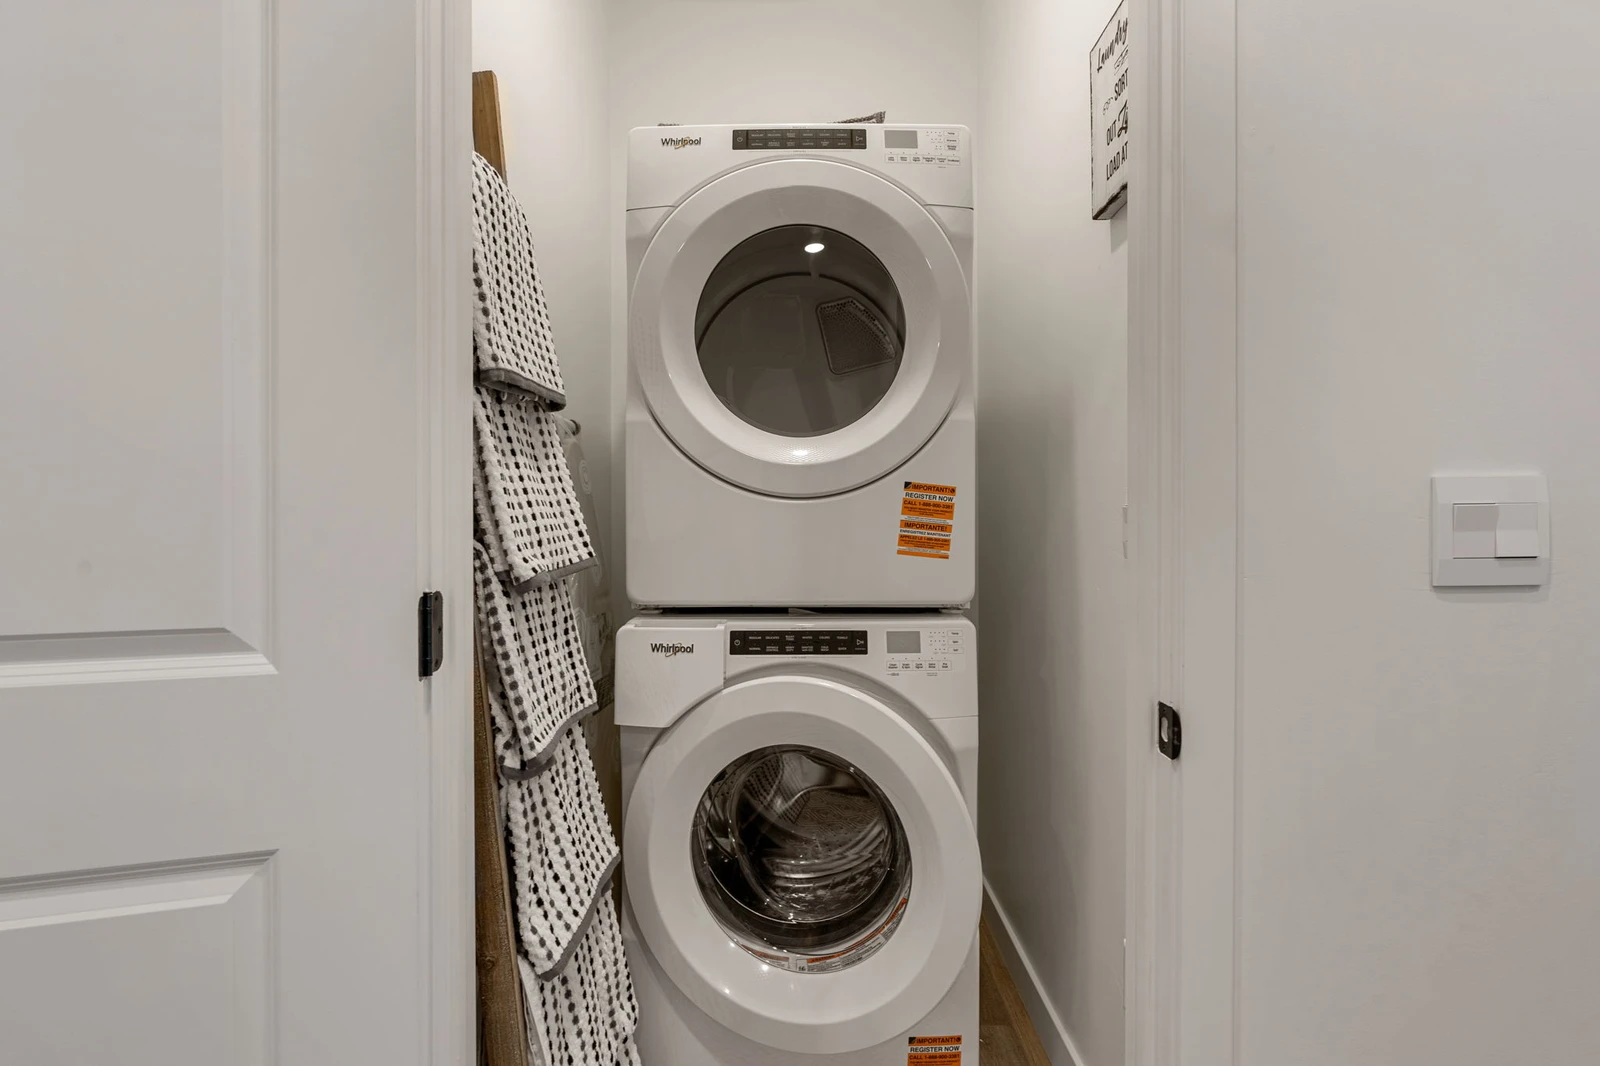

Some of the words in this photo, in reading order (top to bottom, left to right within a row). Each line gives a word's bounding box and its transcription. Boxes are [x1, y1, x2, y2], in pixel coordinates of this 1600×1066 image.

[1114, 68, 1128, 101] SORT
[661, 137, 701, 148] Whirlpool
[1107, 119, 1117, 146] OUT
[1106, 151, 1121, 181] LOAD
[905, 492, 937, 501] REGISTER
[650, 643, 694, 656] Whirlpool
